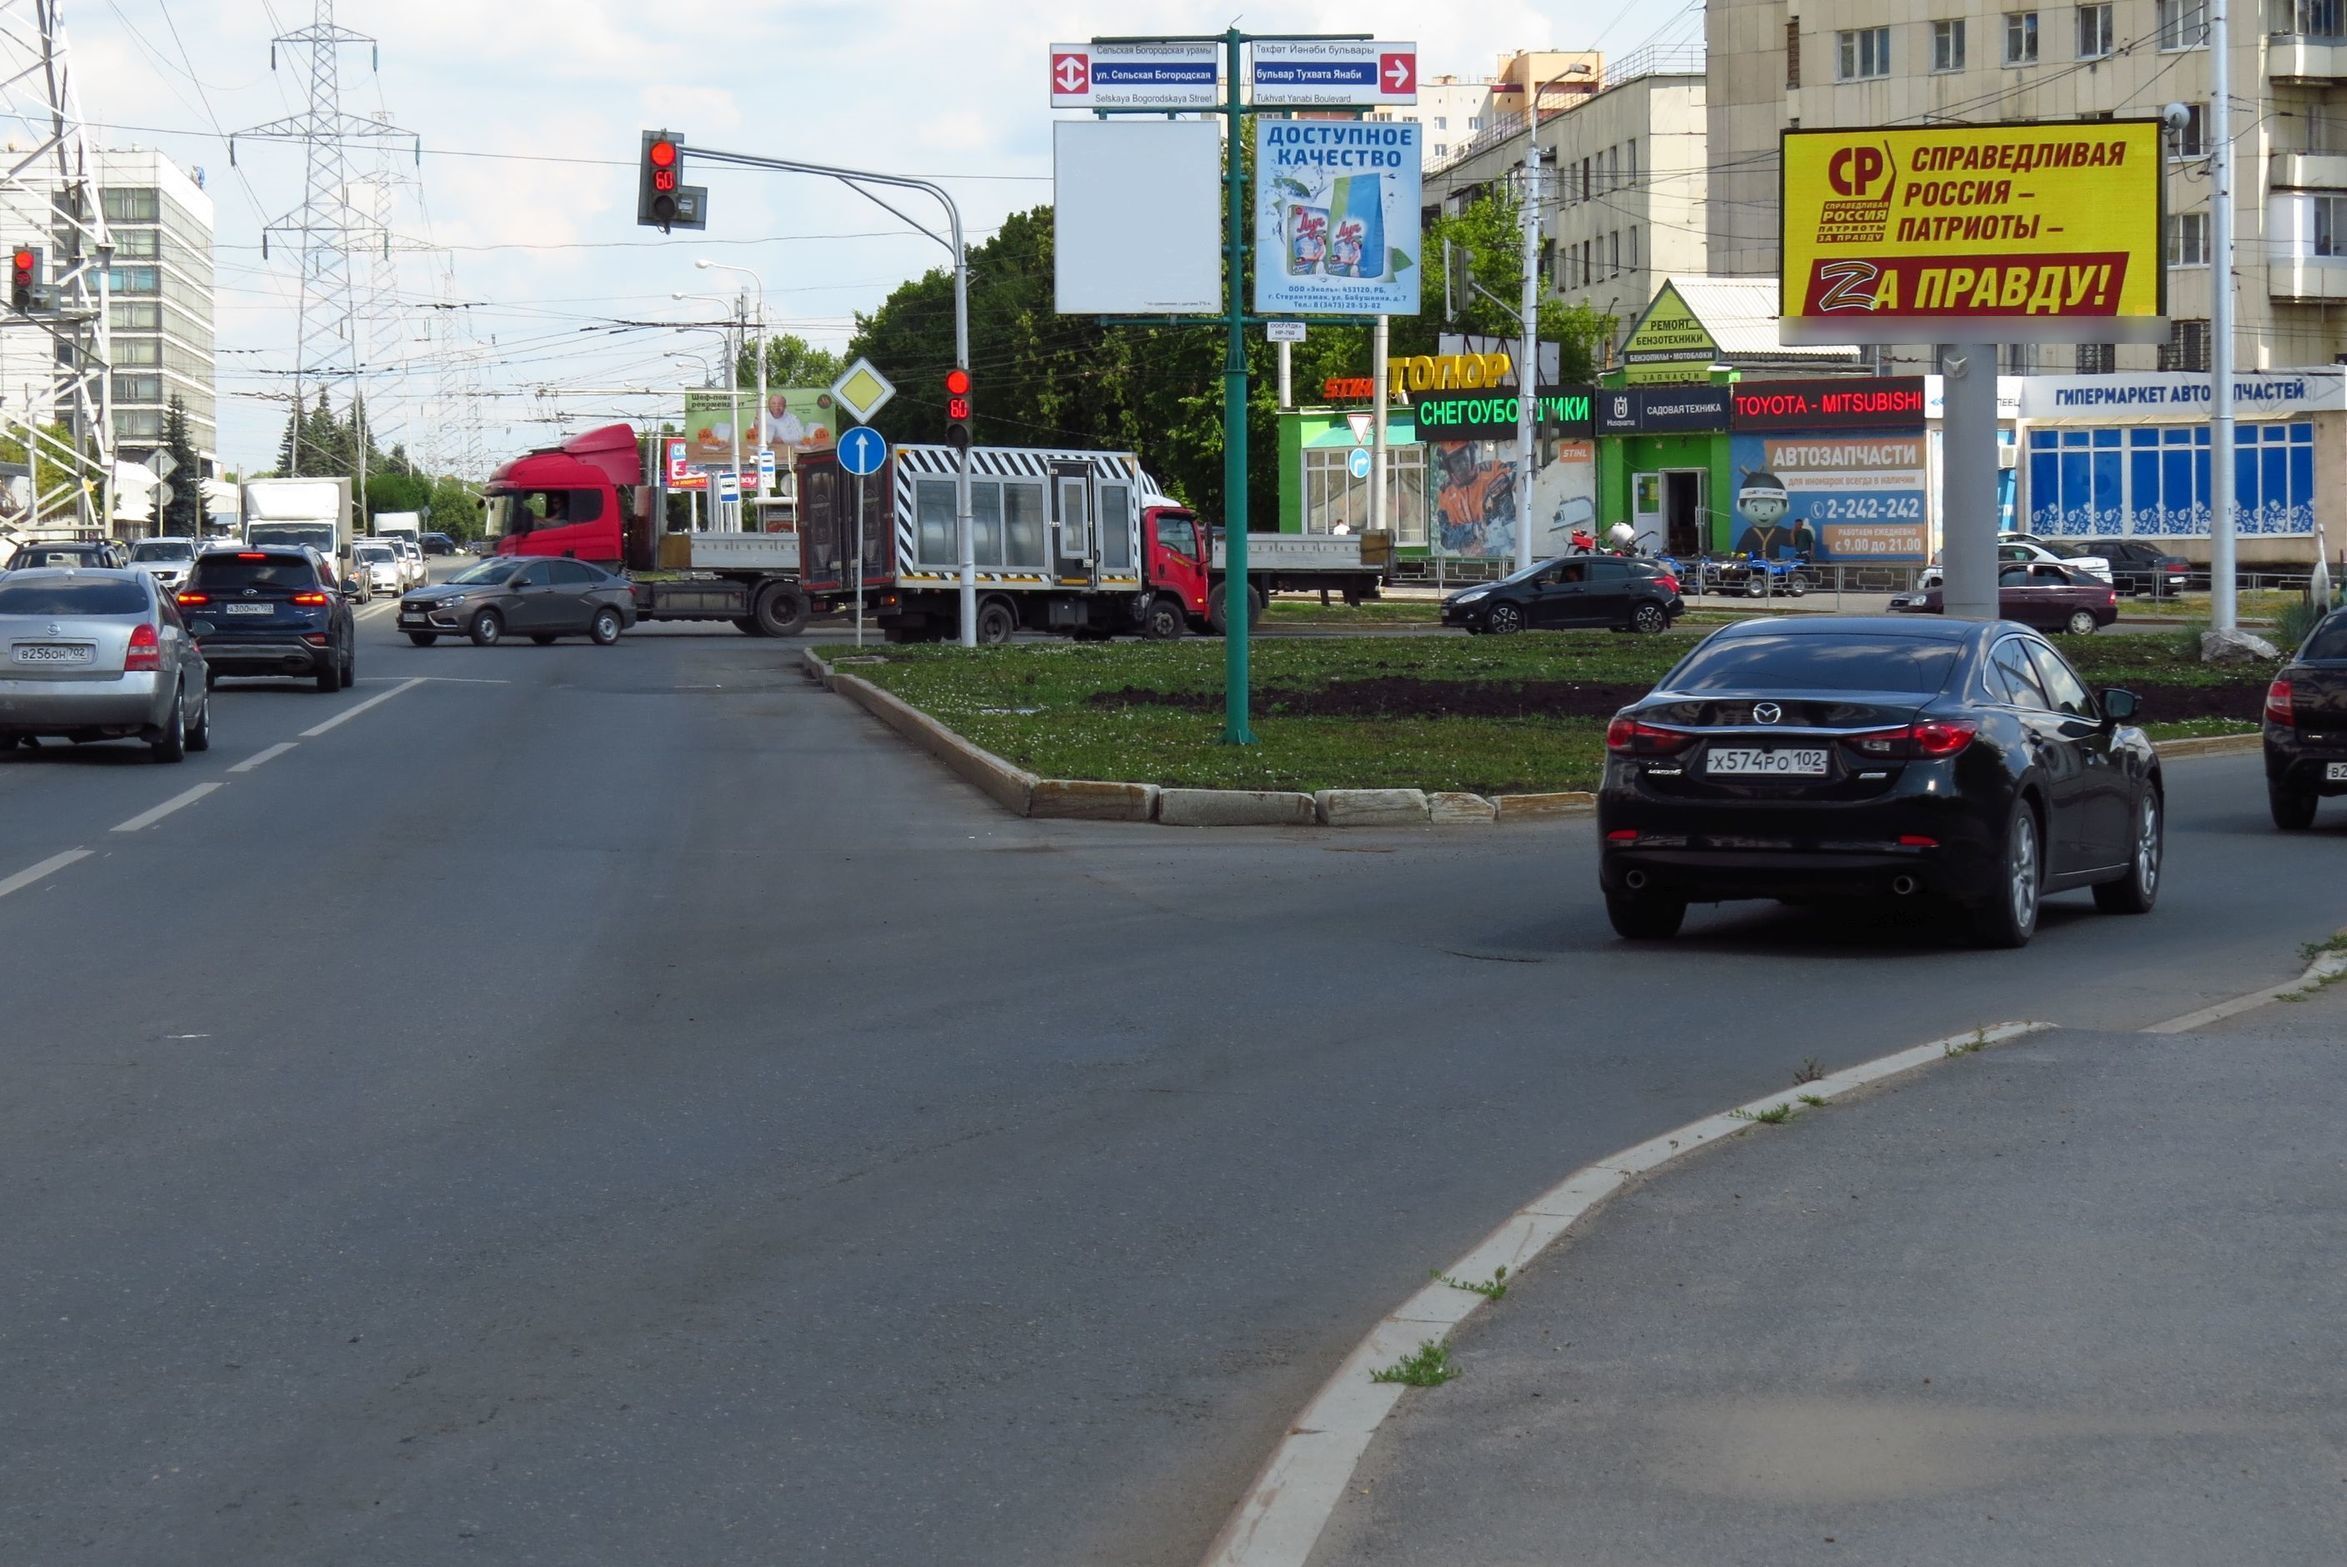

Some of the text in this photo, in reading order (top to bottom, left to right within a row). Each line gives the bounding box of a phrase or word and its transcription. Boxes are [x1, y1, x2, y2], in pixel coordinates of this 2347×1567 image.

[1096, 45, 1212, 56] Сельская Богородская урамы
[1328, 44, 1375, 56] бульвары
[1096, 70, 1211, 81] ул. Сельская Богородская
[1256, 68, 1362, 80] бульвар Тухвата Янаби
[1095, 94, 1212, 104] Selskaya Bogorodskaya Street
[1256, 94, 1352, 103] Tukhvat Yanabi Boulevard
[1267, 126, 1412, 146] ДОСТУПНОЕ
[1278, 149, 1401, 167] КАЧЕСТВО
[1911, 141, 2127, 174] СПРАВЕДЛИВАЯ
[1828, 146, 1884, 196] СР
[656, 171, 674, 190] 60
[1903, 180, 2012, 208] РОССИЯ
[1825, 202, 1889, 210] СПРАВЕДЛИВАЯ
[1822, 210, 1887, 222] РОССИЯ
[1818, 224, 1886, 233] ПАТРИОТЫ
[1896, 214, 2040, 242] ПАТРИОТЫ
[1818, 233, 1882, 242] ЗА ПРАВДУ
[1914, 264, 2112, 314] ПРАВДУ!
[1650, 320, 1690, 332] РЕМОНТ
[1636, 334, 1703, 346] БЕНЗОТЕХНИКИ
[1630, 352, 1713, 362] БЕНЗОПИЛЫ МОТОБЛОКИ
[1386, 353, 1511, 394] ТОПОР
[1642, 373, 1700, 381] ЗАПЧАСТИ
[2056, 386, 2167, 406] ГИПЕРМАРКЕТ
[2170, 378, 2305, 402] АВТОПЧАСТЕЙ
[950, 400, 968, 418] 60
[1646, 403, 1722, 416] САДОВАЯ ТЕХНИКА
[1736, 395, 1807, 416] TOYOTA
[1822, 391, 1922, 412] MITSUBISHI
[1562, 449, 1588, 458] STIHL
[1772, 444, 1917, 467] АВТОЗАПЧАСТИ
[1788, 478, 1803, 487] для
[1846, 476, 1872, 487] всегда
[1826, 498, 1920, 519] 2-242-242
[1838, 528, 1917, 536] РАБОТАЕМ ЕЖЕДНЕВНО
[1835, 538, 1920, 553] с 9.00 до 21.00
[1793, 752, 1822, 766] 102
